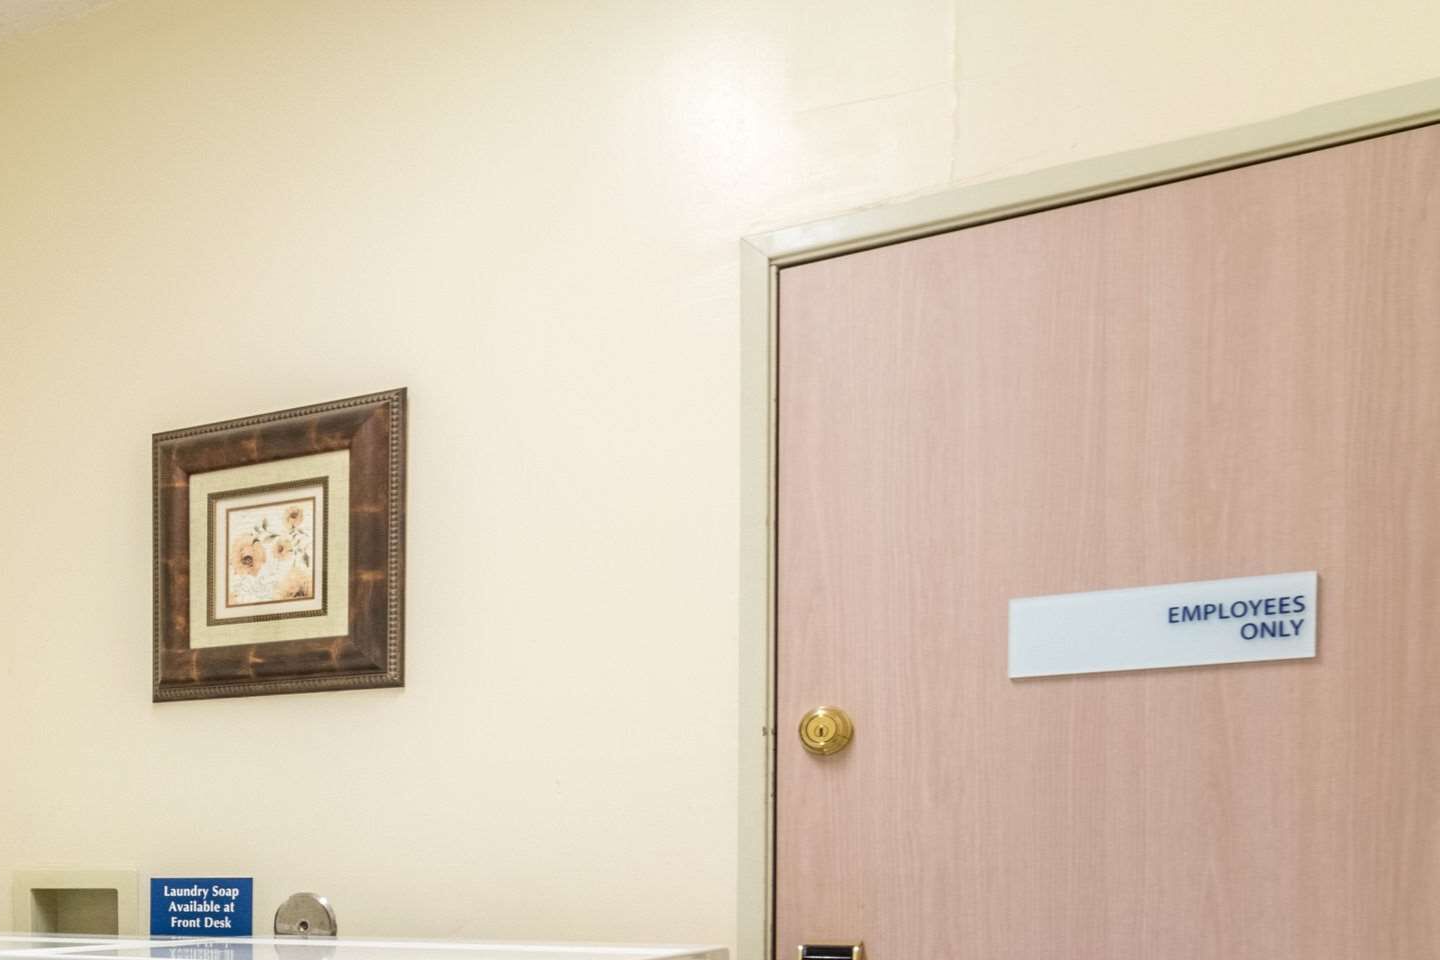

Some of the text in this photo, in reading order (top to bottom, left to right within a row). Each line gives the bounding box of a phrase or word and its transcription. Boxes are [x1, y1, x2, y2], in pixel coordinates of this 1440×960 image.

[1168, 595, 1306, 624] EMPLOYEES
[1240, 619, 1305, 640] ONLY
[163, 885, 240, 899] Laundry Soap
[168, 901, 235, 913] Available at
[171, 917, 232, 928] Front Desk
